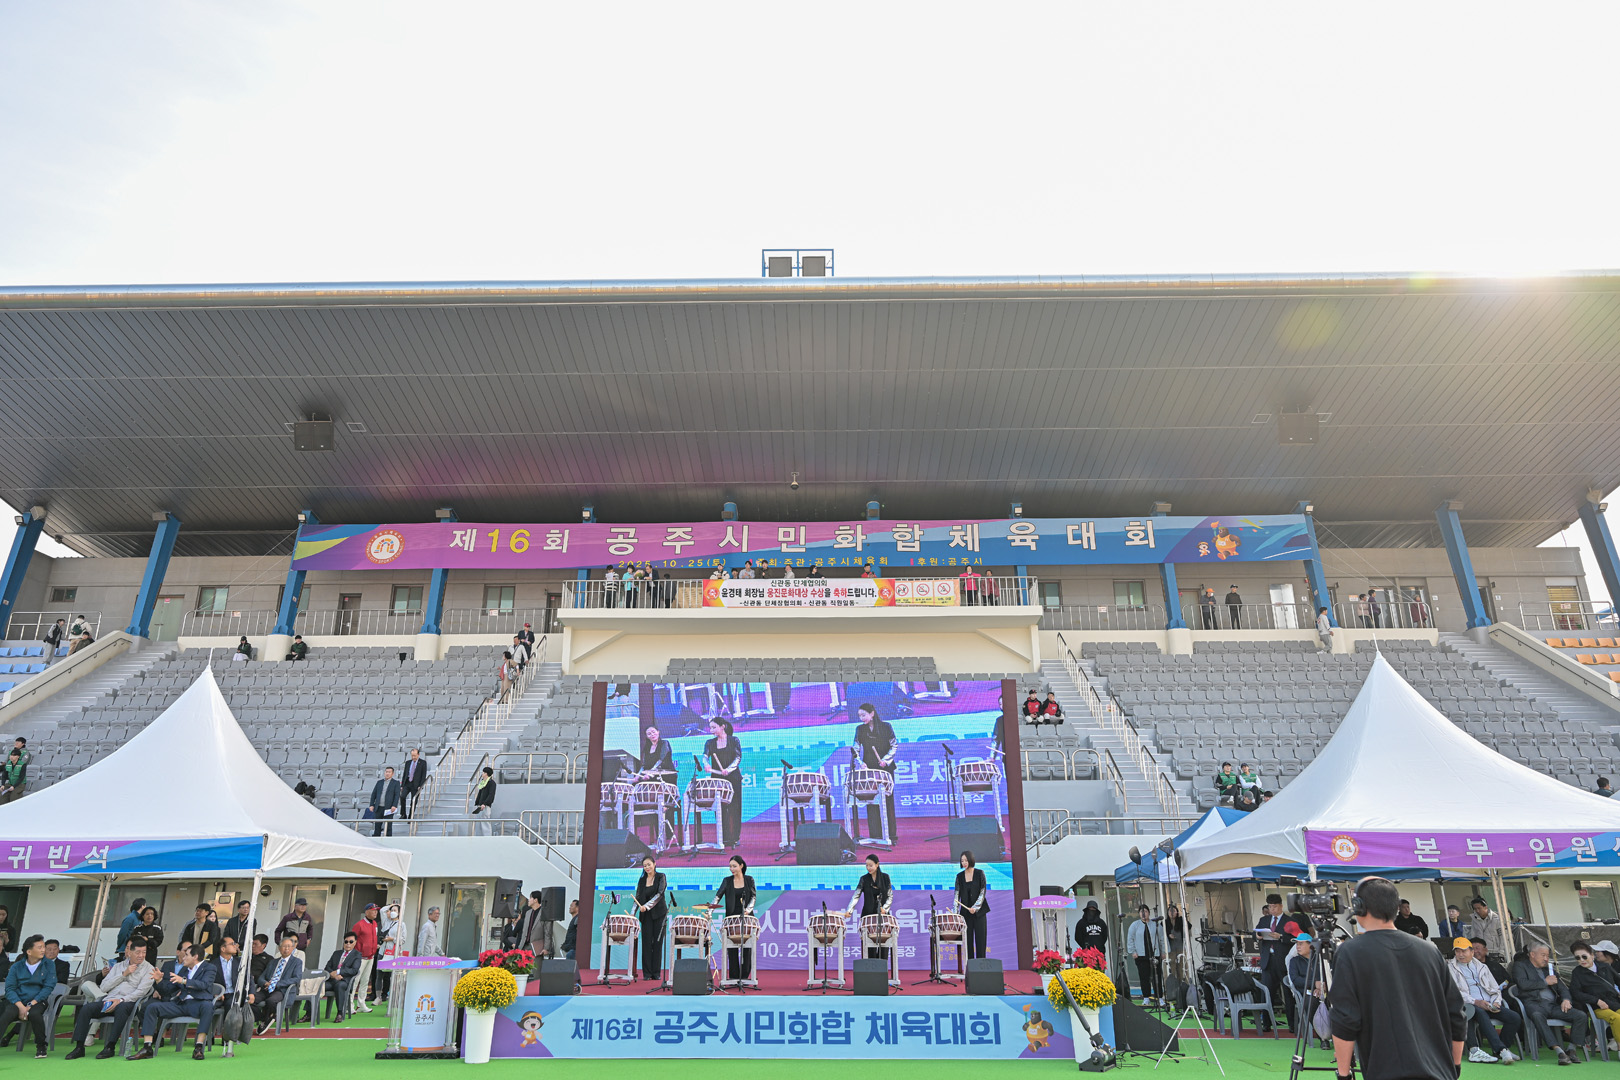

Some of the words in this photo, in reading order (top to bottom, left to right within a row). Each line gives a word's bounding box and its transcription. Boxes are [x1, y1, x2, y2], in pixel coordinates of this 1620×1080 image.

[449, 527, 570, 554] 제16회
[605, 519, 1156, 557] 공주시민화합체육대회
[744, 588, 765, 598] 회장님
[810, 588, 831, 597] 수상을
[833, 587, 877, 597] 축하드립니다.
[415, 1014, 435, 1022] 공주시
[571, 1017, 643, 1041] 제16회
[653, 1010, 856, 1045] 공주시민화합
[865, 1011, 1002, 1045] 체육대회
